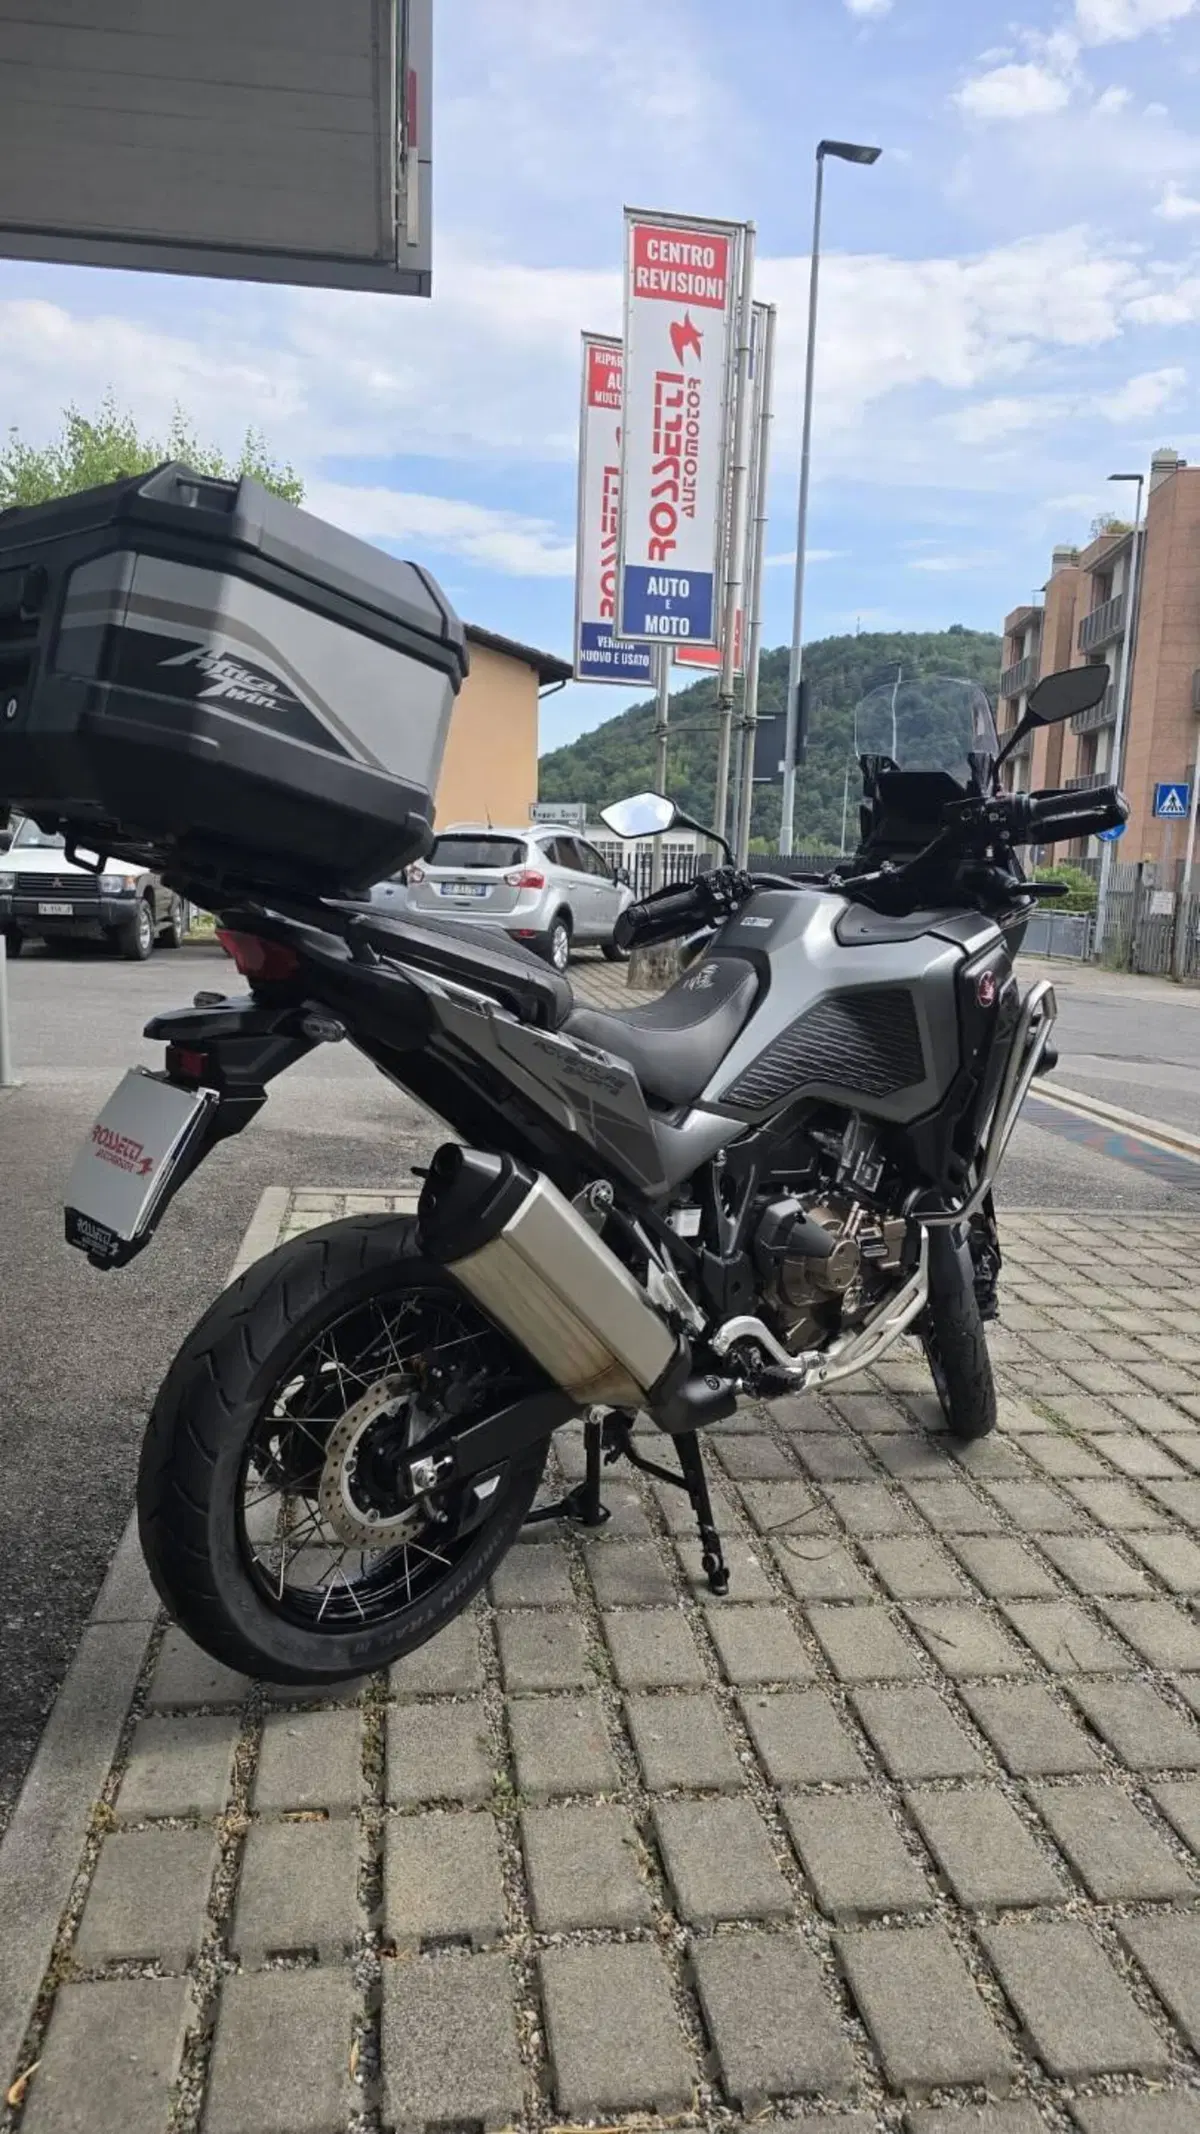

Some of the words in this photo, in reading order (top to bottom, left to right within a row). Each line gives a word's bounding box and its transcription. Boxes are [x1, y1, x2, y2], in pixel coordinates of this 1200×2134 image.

[647, 239, 715, 269] CENTRO
[636, 266, 724, 300] REVISIONI
[681, 377, 701, 519] AUTOMOTOR
[648, 371, 685, 562] ROSSETTI
[647, 576, 690, 598] AUTO
[665, 599, 672, 610] E
[644, 615, 690, 636] MOTO
[580, 649, 612, 664] NUOVO
[614, 652, 620, 665] E
[621, 653, 650, 667] USATO
